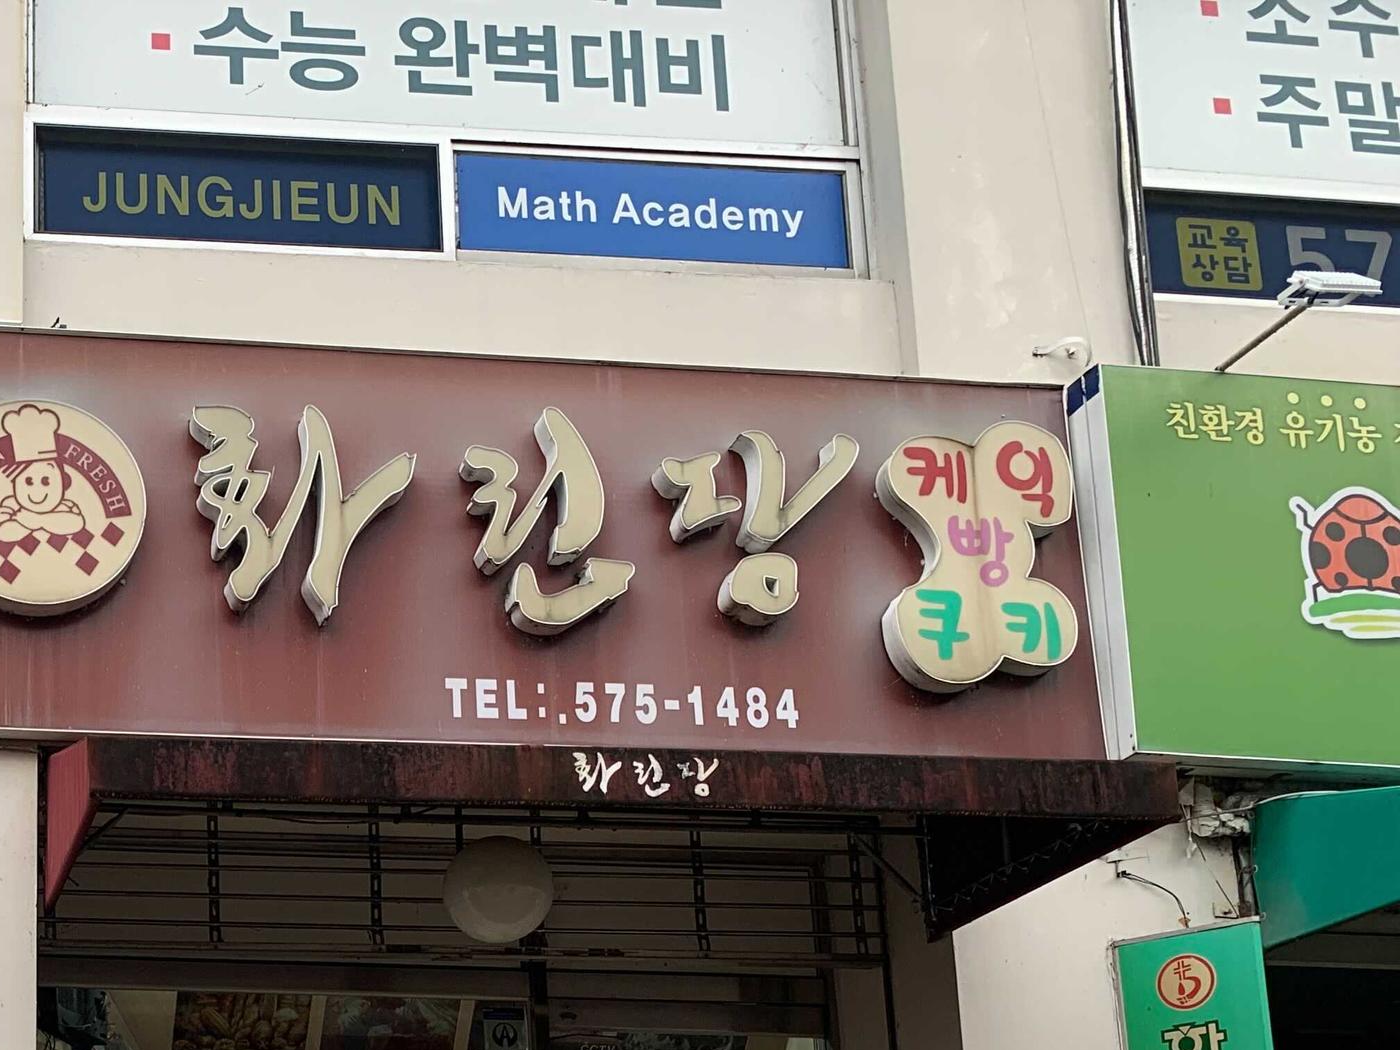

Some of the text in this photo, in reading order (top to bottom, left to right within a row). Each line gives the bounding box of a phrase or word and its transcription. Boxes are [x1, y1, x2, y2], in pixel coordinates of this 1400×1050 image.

[193, 5, 729, 113] 수능 완벽대비
[83, 170, 401, 226] JUNGJIEUN
[496, 185, 804, 239] Math Academy
[1188, 224, 1249, 253] 교육
[1192, 254, 1252, 284] 상담
[1166, 402, 1265, 445] 친환경
[1280, 410, 1383, 454] 유기농
[63, 443, 126, 511] FRESH
[903, 440, 1055, 518] 케익
[948, 515, 1015, 588] 빵
[915, 589, 1062, 661] 쿠키
